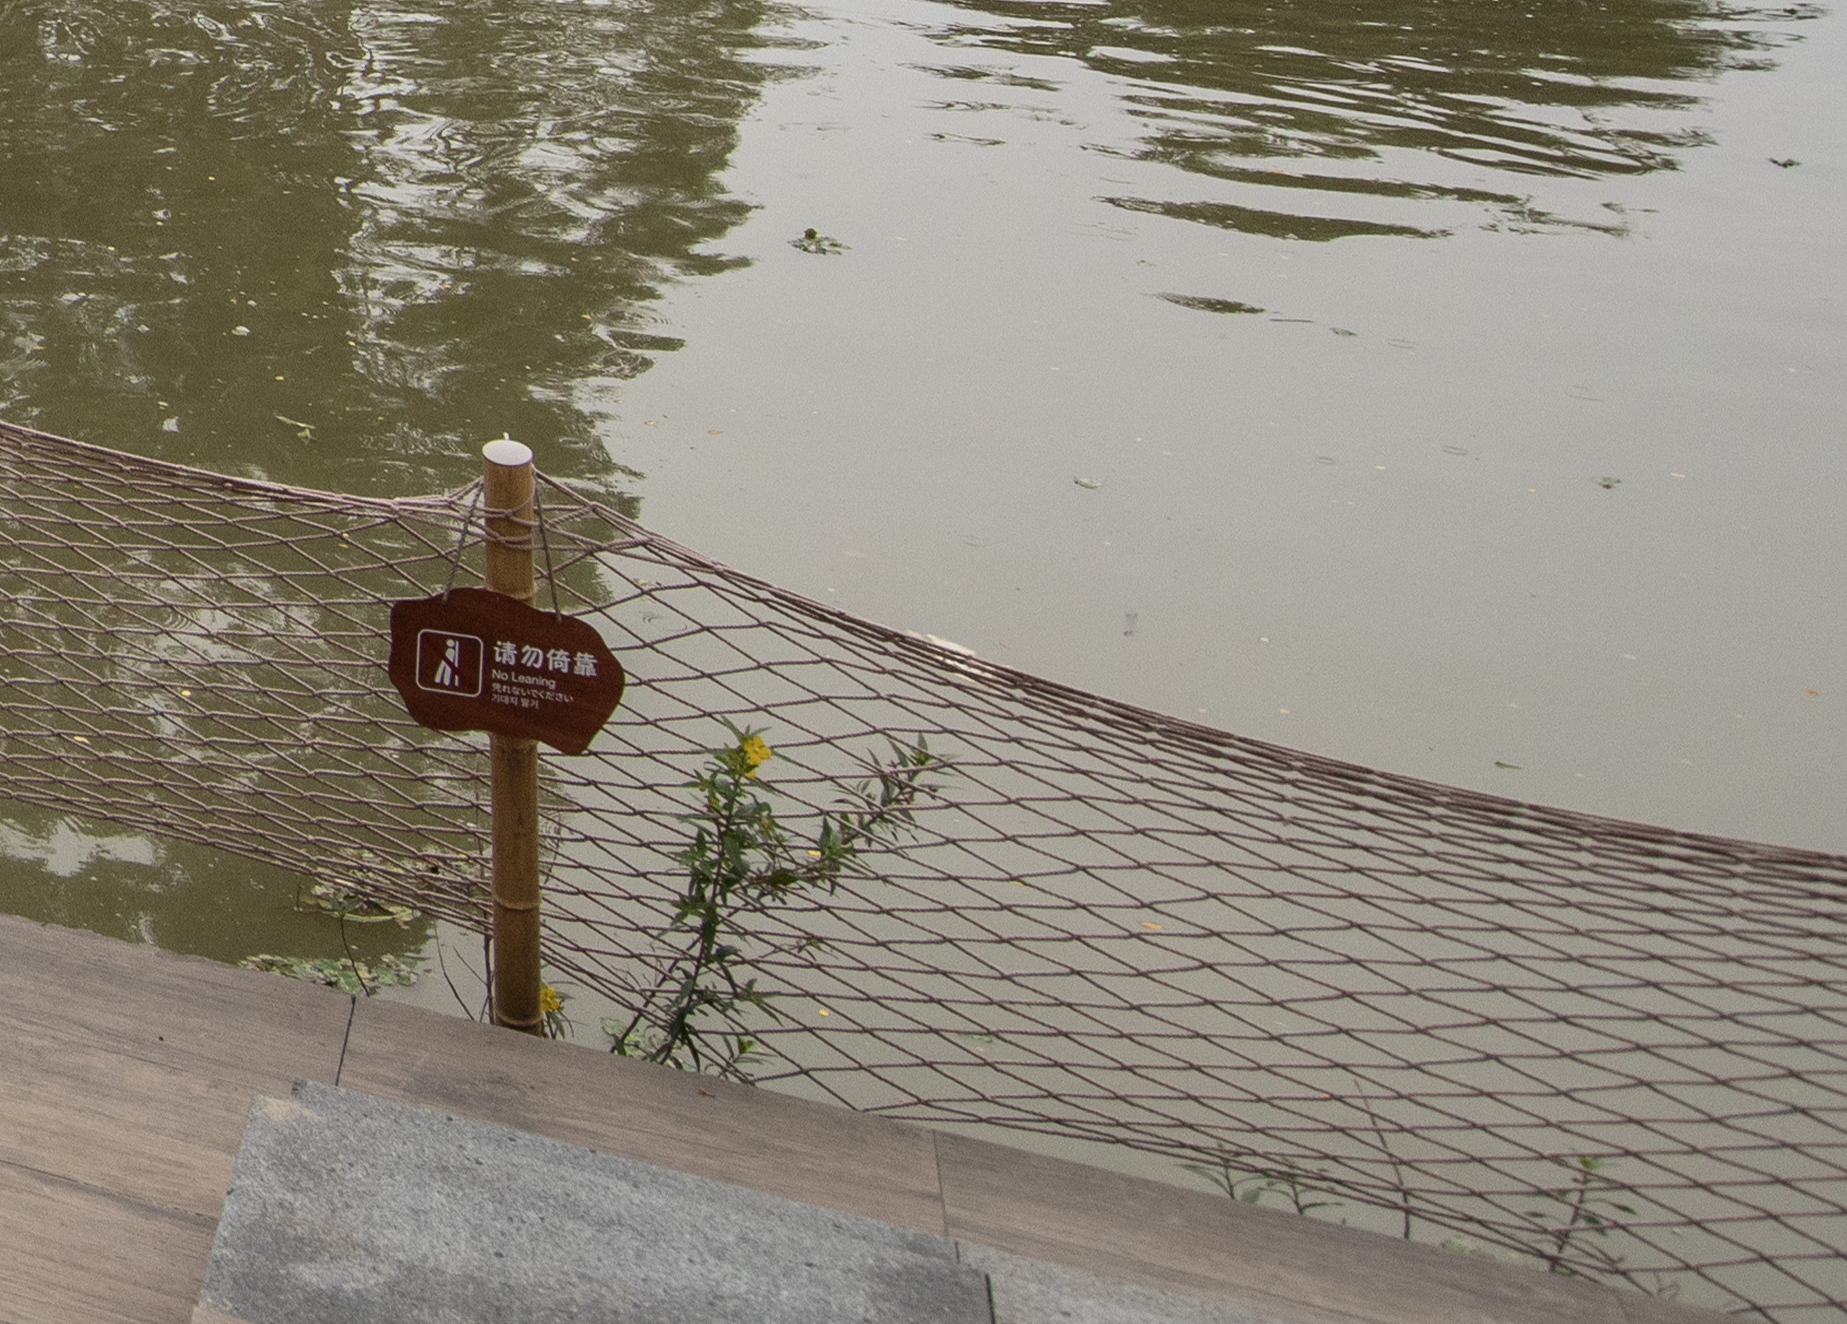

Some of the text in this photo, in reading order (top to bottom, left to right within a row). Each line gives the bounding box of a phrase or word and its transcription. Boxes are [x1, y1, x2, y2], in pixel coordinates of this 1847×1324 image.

[493, 641, 598, 677] 请勿倚靠
[491, 669, 556, 689] No Leaning
